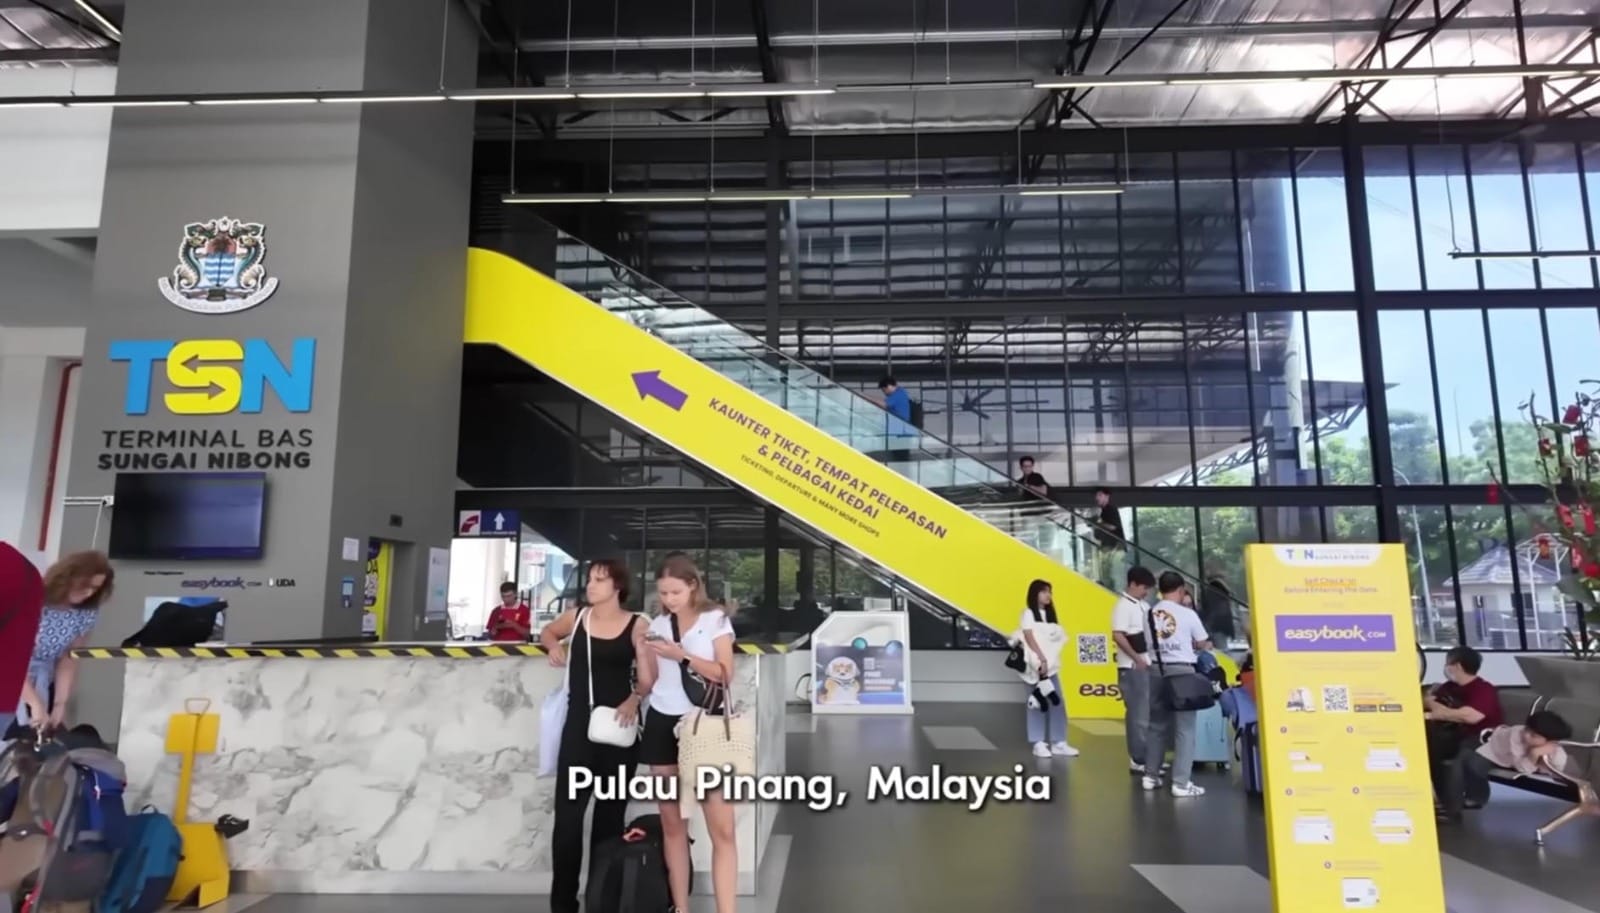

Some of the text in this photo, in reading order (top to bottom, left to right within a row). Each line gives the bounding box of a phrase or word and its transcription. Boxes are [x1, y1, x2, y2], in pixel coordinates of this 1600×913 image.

[109, 337, 317, 416] TSN
[98, 452, 311, 470] SUNGAI NIBONG
[102, 429, 313, 449] TERMINAL BAS
[708, 397, 948, 540] KAUNTER TIKET, TEMPAT PELEPASAN
[757, 444, 880, 520] & PELBAGAI KEDAI
[276, 578, 296, 588] UDA
